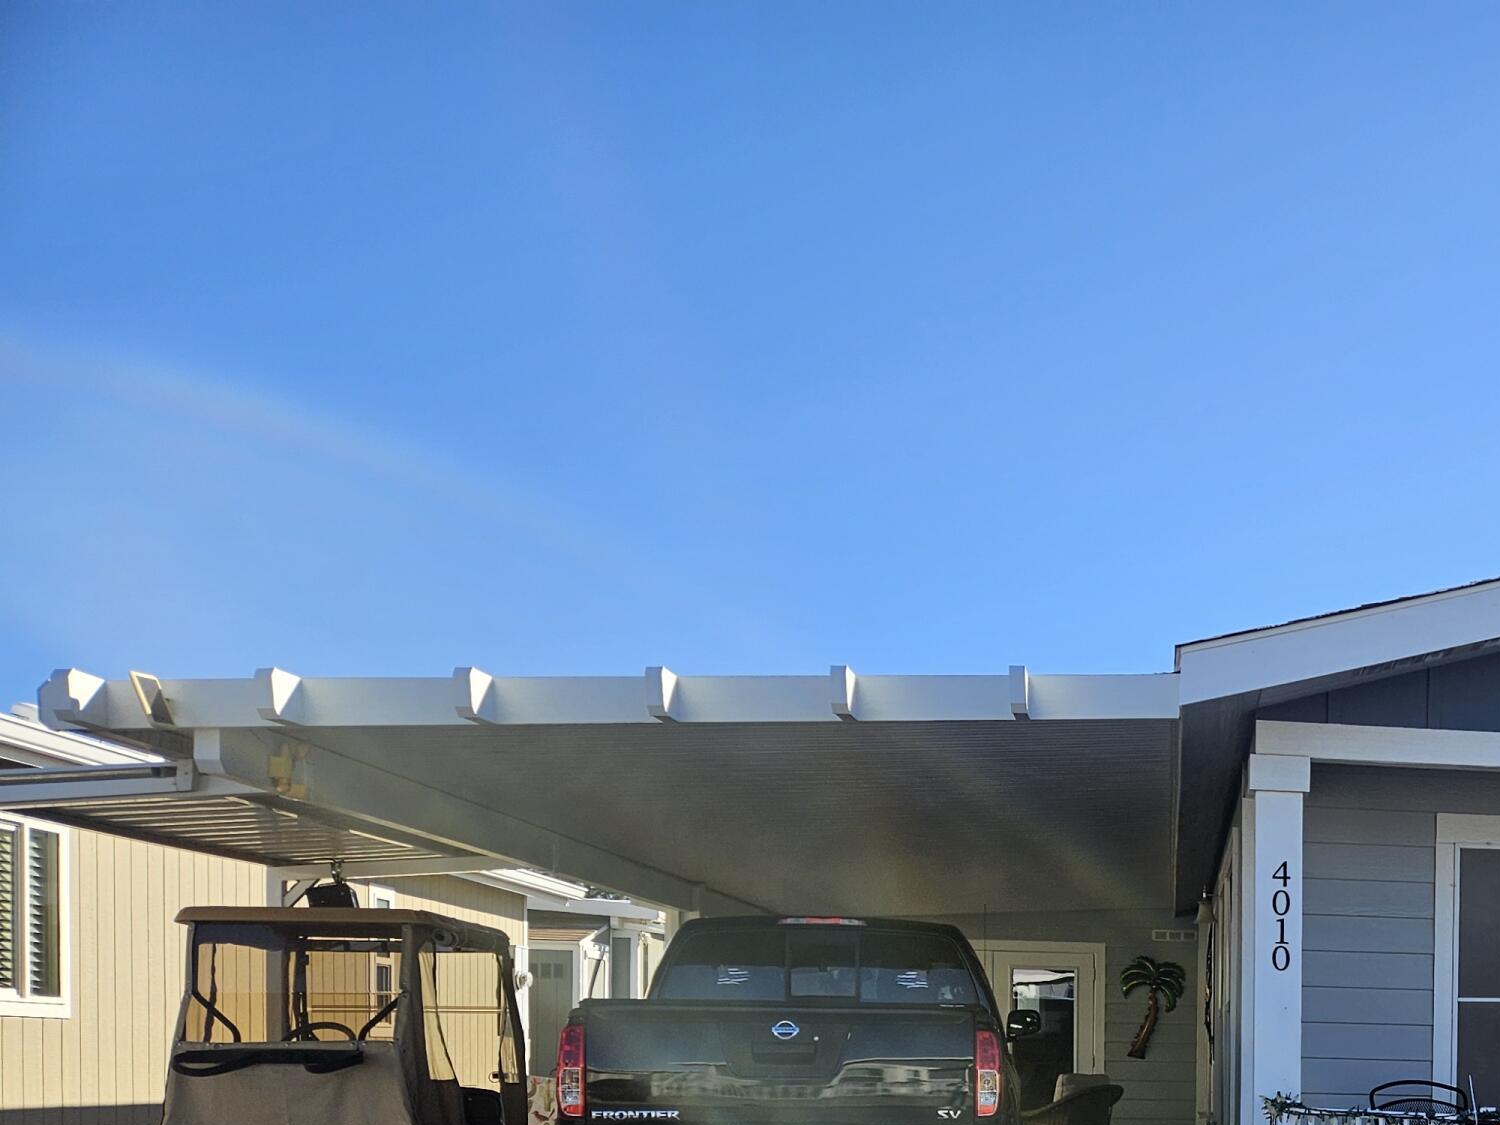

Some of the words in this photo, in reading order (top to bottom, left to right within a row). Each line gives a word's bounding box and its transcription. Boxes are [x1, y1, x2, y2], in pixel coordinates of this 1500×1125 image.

[1272, 861, 1291, 971] 4010
[591, 1110, 680, 1120] FRONTIER
[937, 1109, 962, 1121] SV
